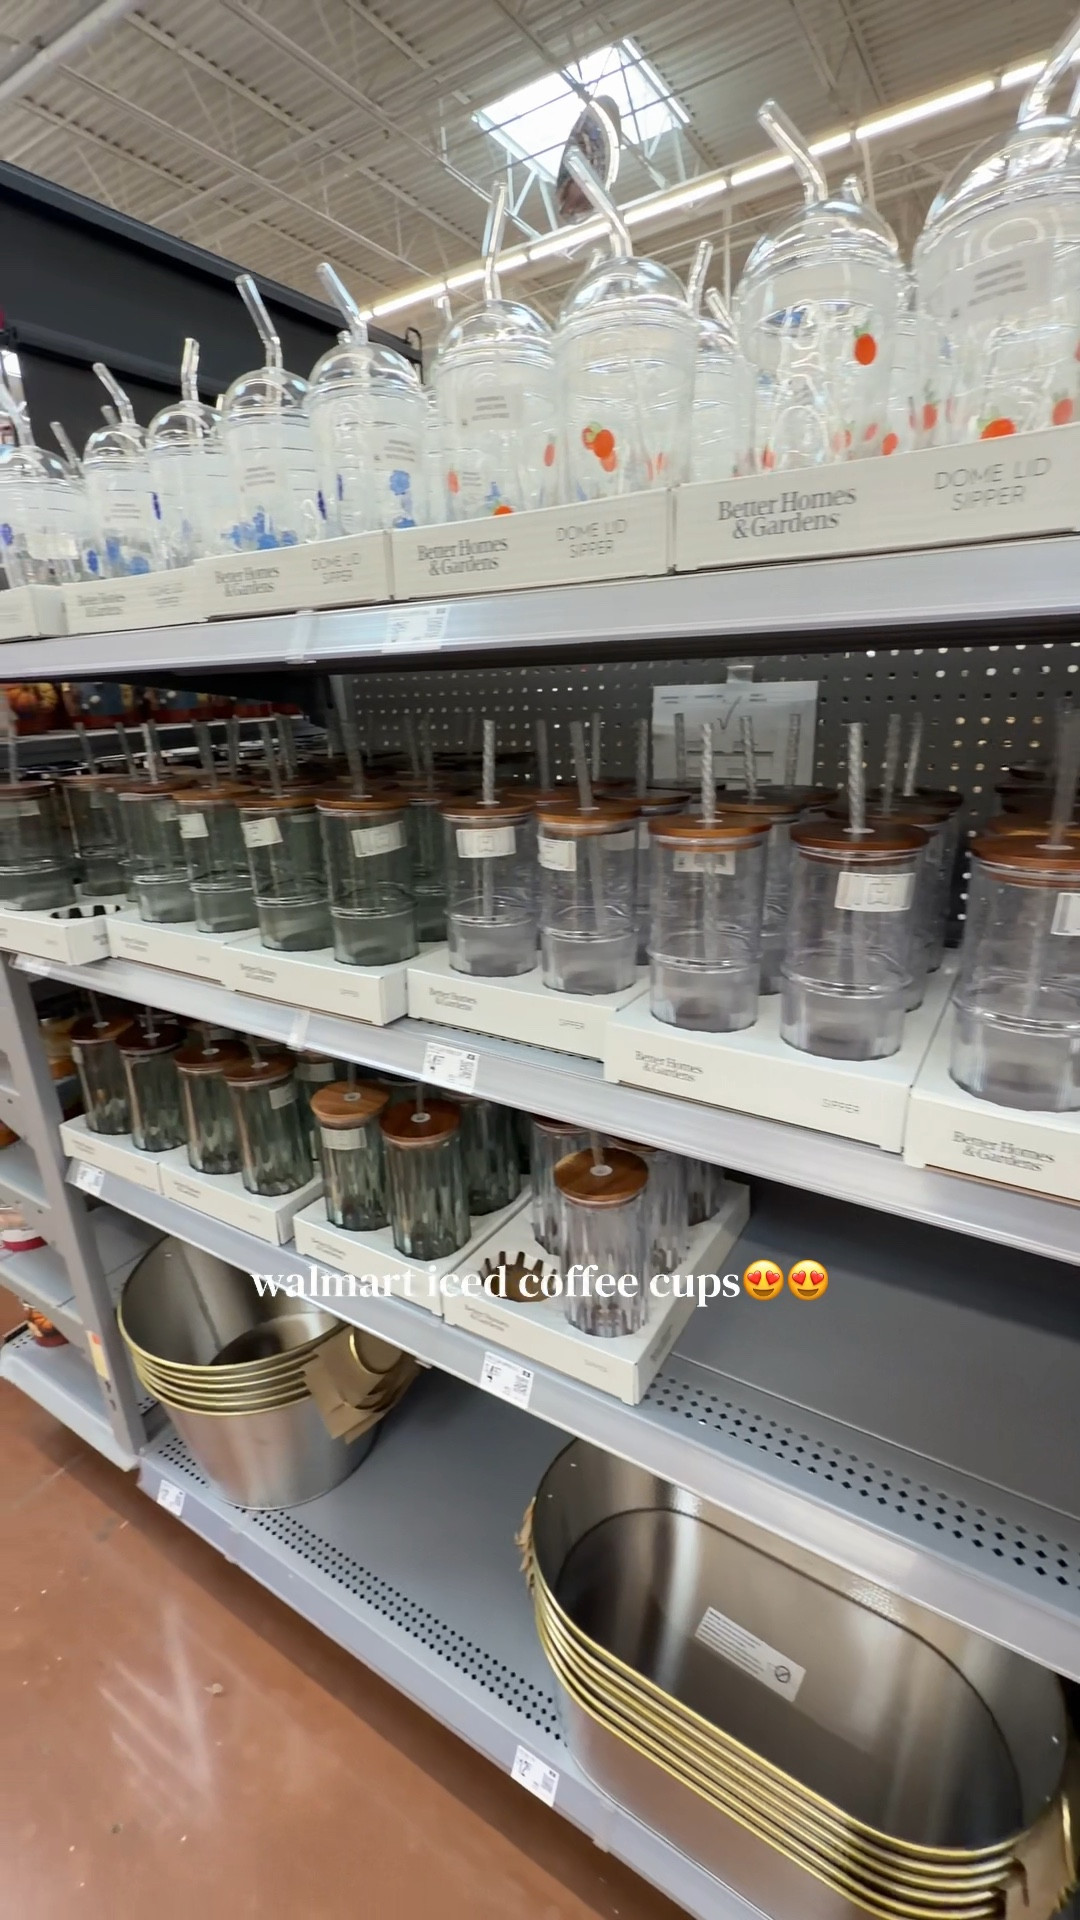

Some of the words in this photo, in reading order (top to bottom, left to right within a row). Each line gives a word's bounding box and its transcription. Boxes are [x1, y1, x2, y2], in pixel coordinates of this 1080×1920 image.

[934, 463, 1003, 490] DOME
[1013, 457, 1051, 480] LID
[718, 500, 778, 521] Better
[780, 488, 857, 513] Homes
[952, 485, 1026, 511] SIPPER
[555, 522, 599, 542] DOME
[458, 538, 509, 555] Homes
